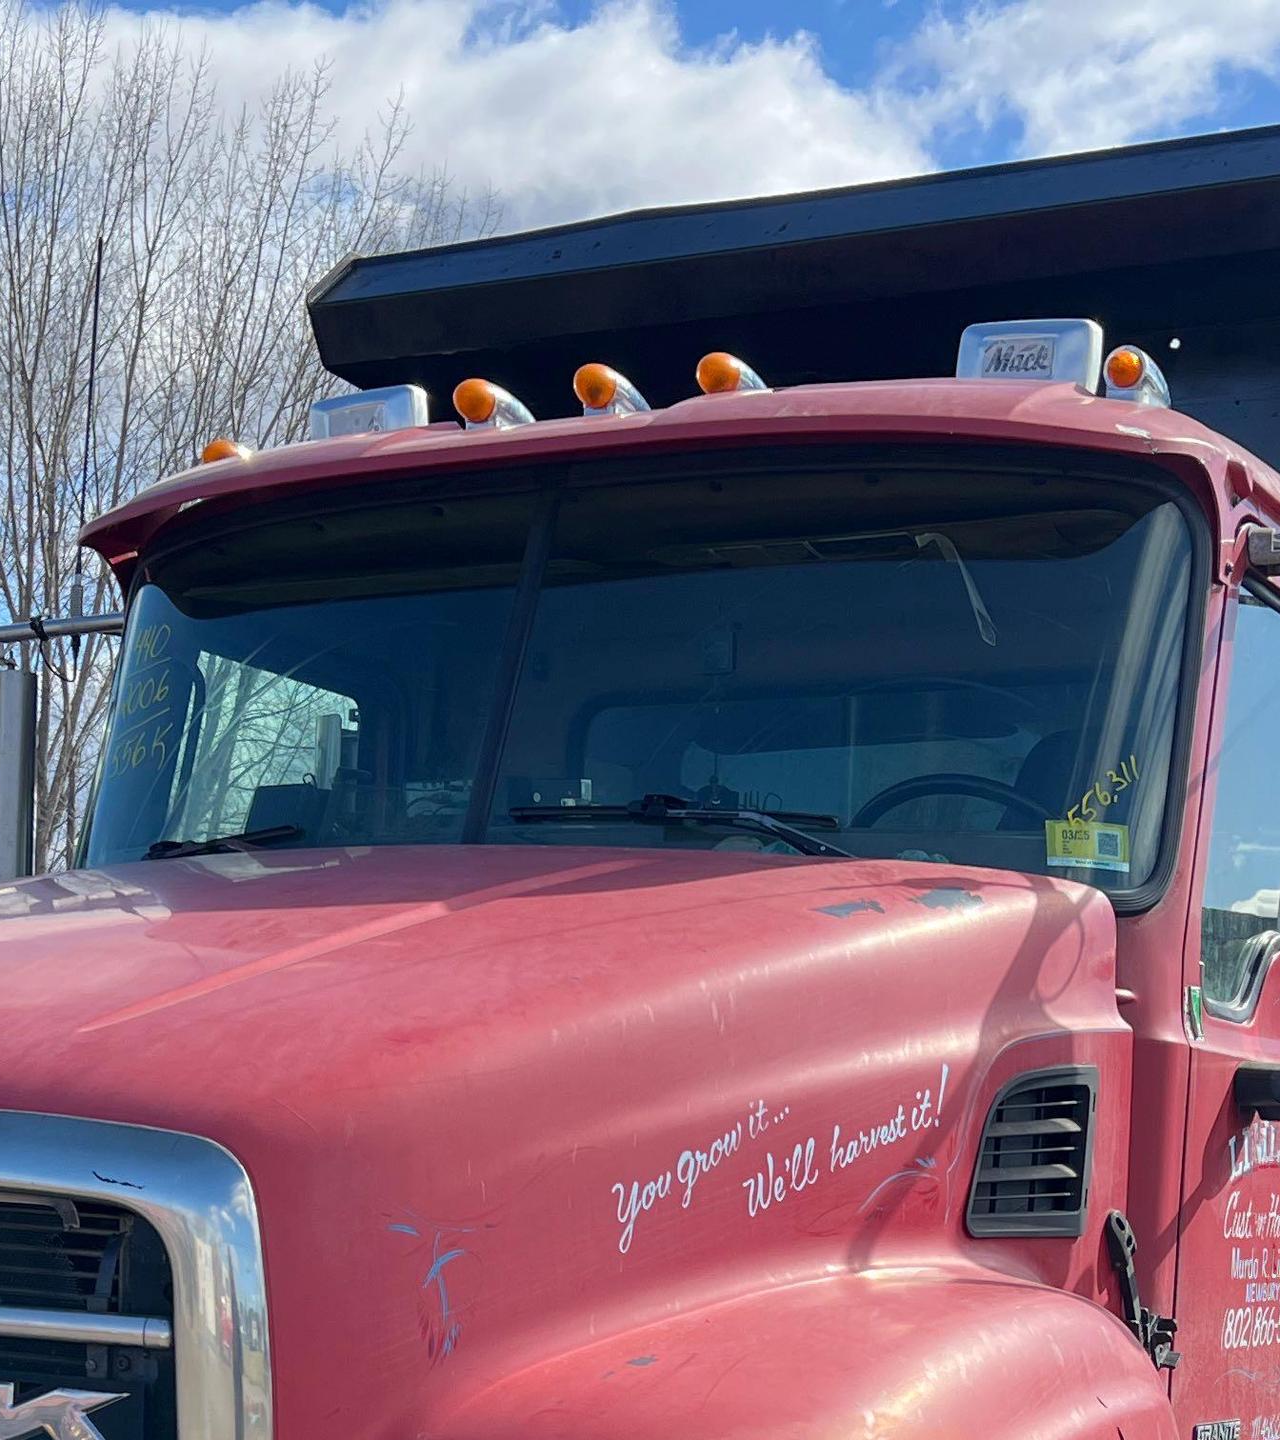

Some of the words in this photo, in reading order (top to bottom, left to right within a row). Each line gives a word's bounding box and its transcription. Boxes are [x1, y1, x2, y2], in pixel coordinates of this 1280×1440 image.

[985, 345, 1048, 373] Mack
[612, 1170, 671, 1254] You
[676, 1121, 742, 1209] grow
[742, 1137, 819, 1218] We'll
[830, 1104, 907, 1173] harvest
[911, 1063, 949, 1128] it!
